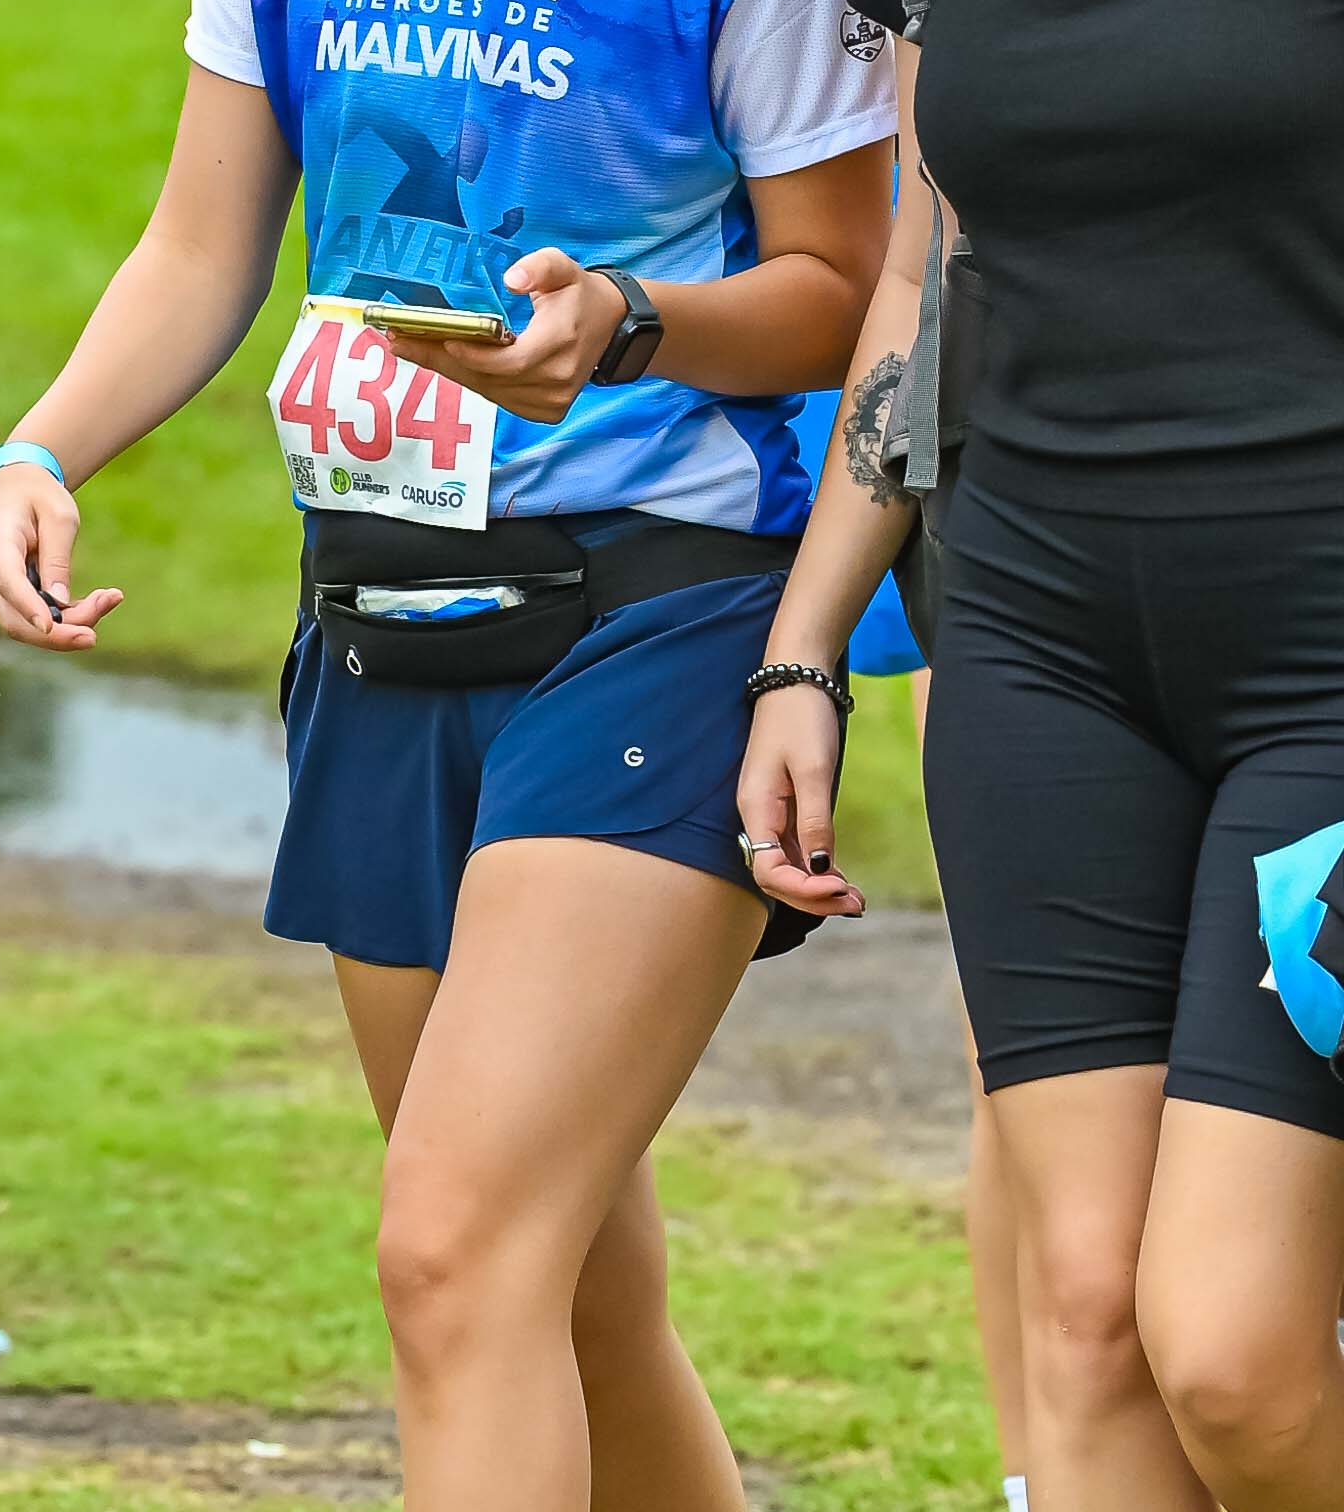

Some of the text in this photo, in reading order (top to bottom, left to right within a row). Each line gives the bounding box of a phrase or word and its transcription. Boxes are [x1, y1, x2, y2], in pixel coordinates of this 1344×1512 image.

[504, 1, 554, 33] DE
[315, 19, 575, 101] MALVINAS
[279, 320, 472, 471] 434
[401, 484, 463, 508] CARUSO
